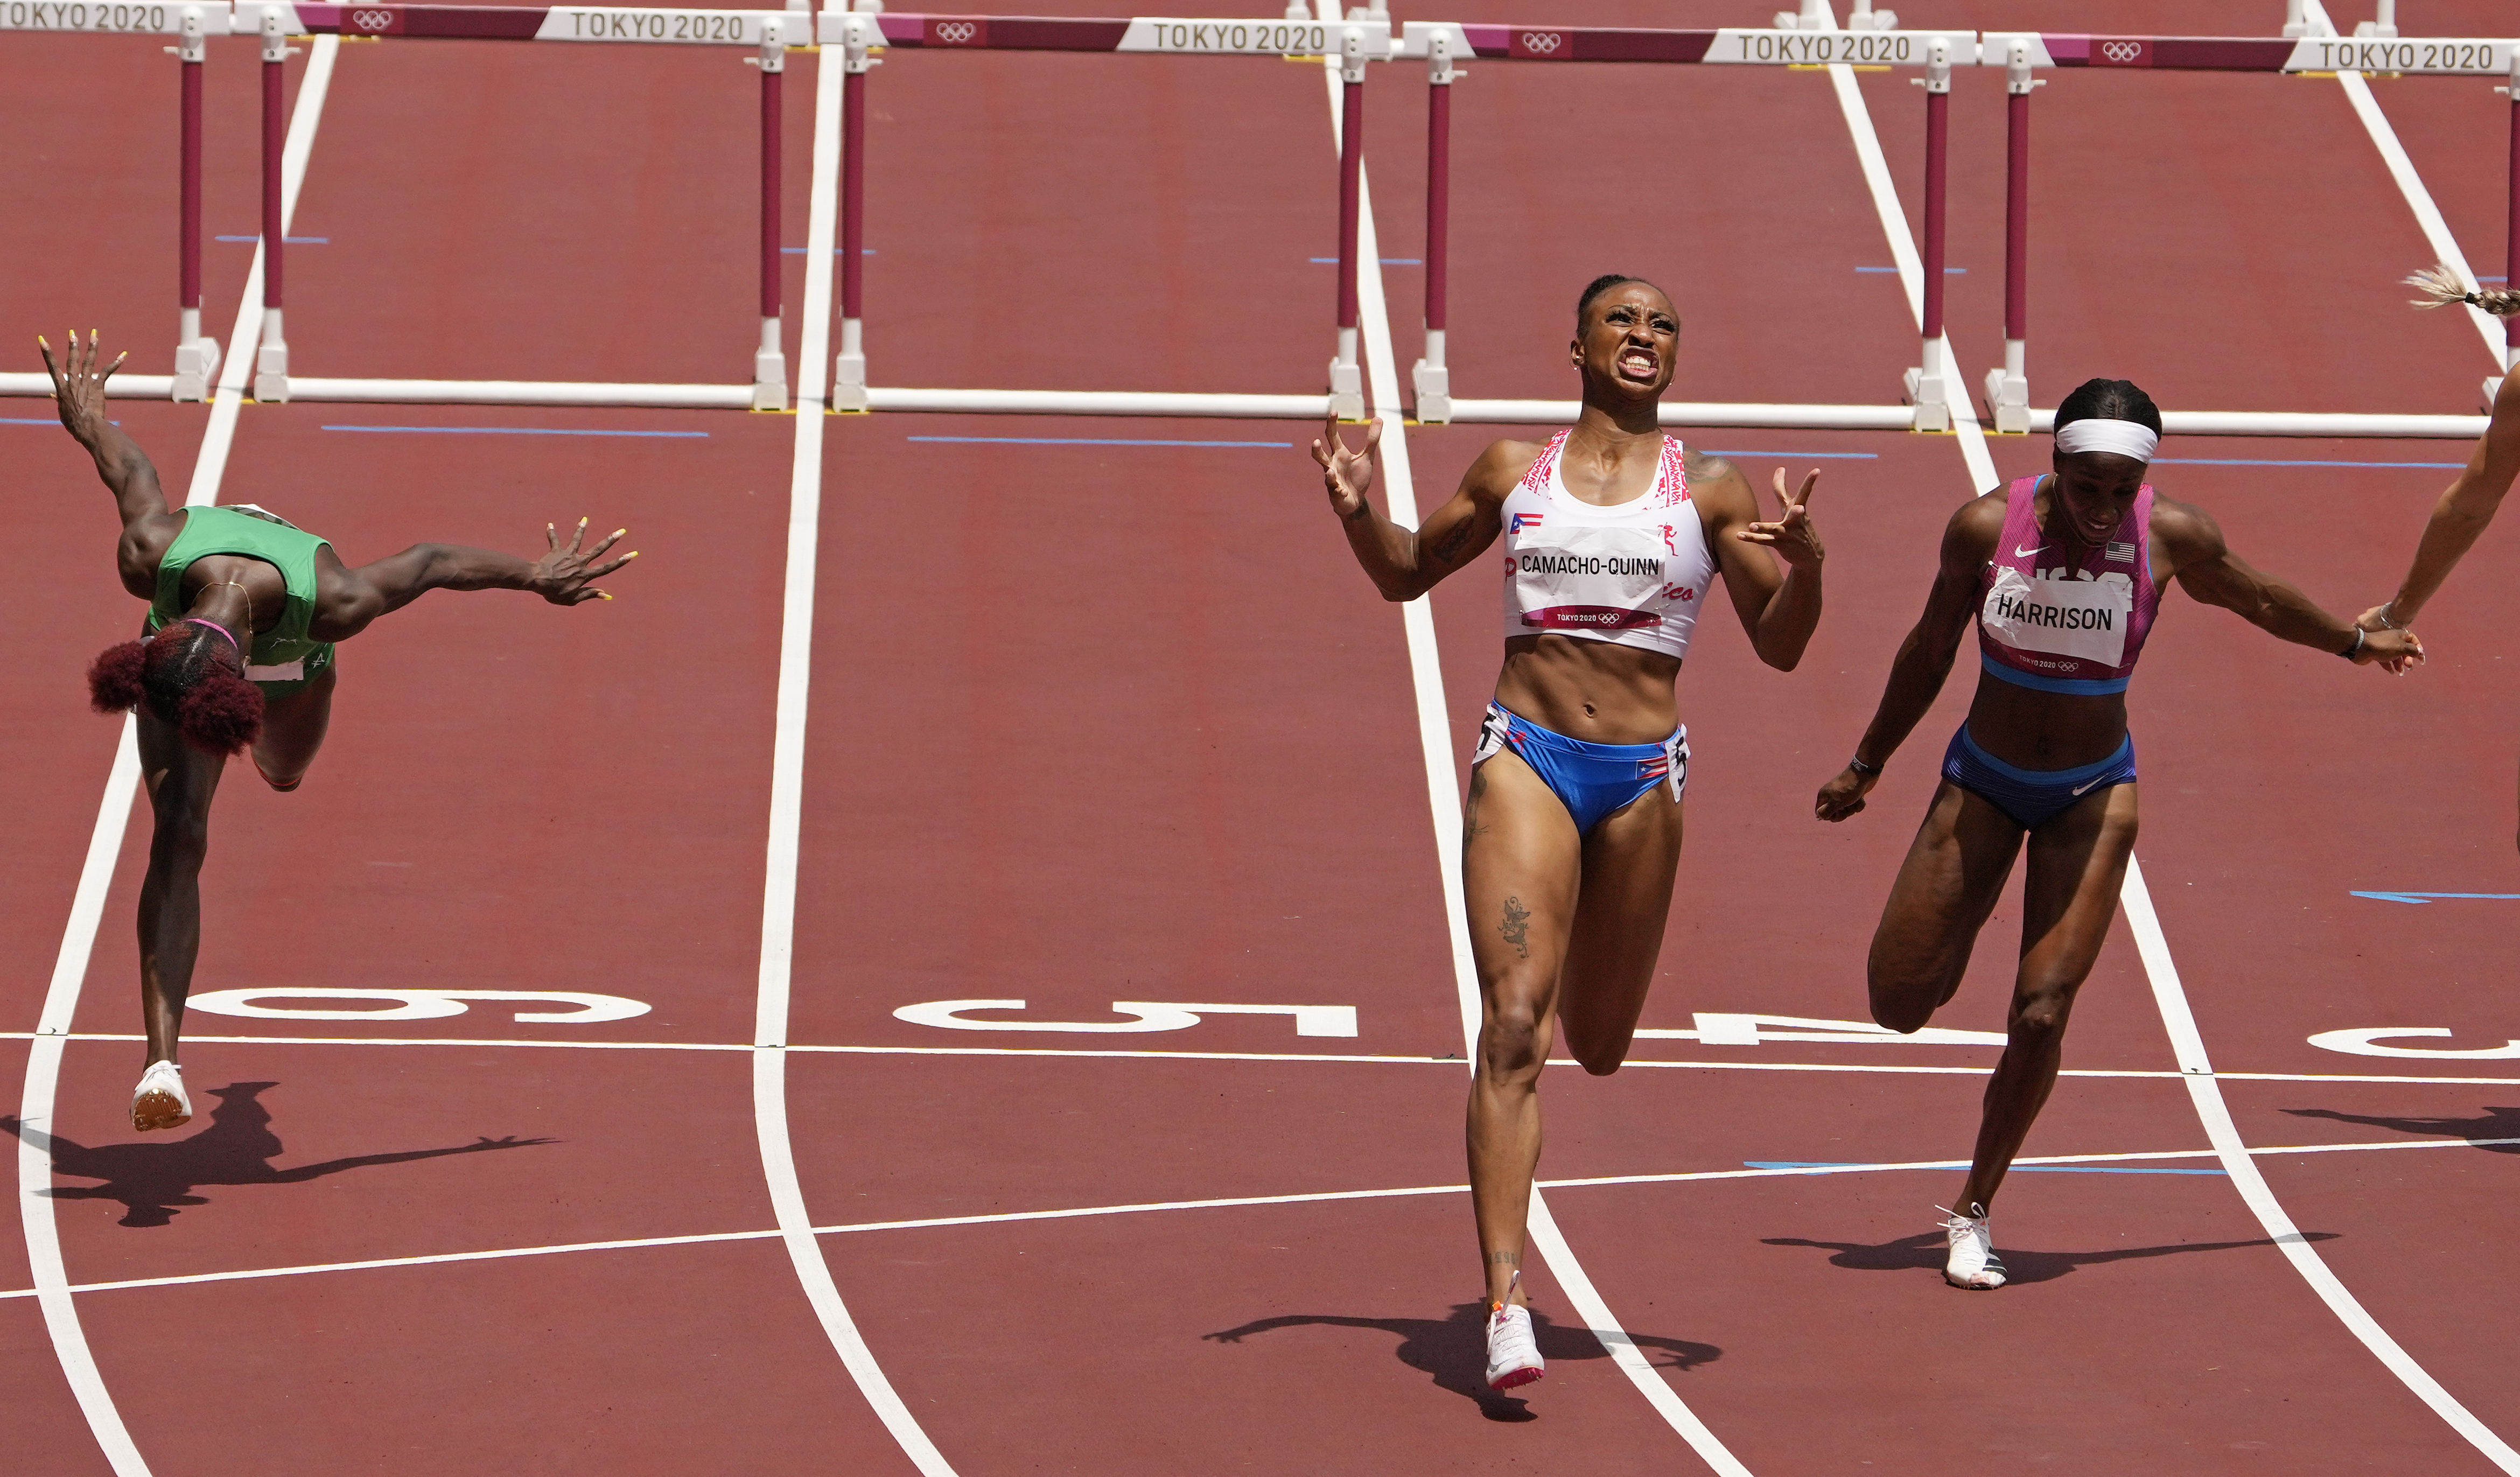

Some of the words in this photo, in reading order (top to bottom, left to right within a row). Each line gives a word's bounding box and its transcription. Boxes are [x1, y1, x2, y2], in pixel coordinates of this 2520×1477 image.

[0, 2, 86, 27] OKYO
[95, 4, 164, 29] 2020
[570, 12, 666, 38] TOKYO
[674, 15, 743, 40] 2020
[1153, 24, 1247, 49] TOKYO
[1256, 25, 1325, 50] 2020
[1738, 36, 1832, 60] TOKYO
[1842, 36, 1910, 60] 2020
[2319, 43, 2416, 68] TOKYO
[2423, 44, 2494, 69] 2020
[1522, 555, 1659, 576] CAMACHO-QUINN
[1997, 593, 2112, 631] HARRISON
[2019, 654, 2039, 666] TOKYO
[2039, 660, 2056, 668] 2020
[184, 987, 652, 1024] 6
[892, 999, 1359, 1037] 5
